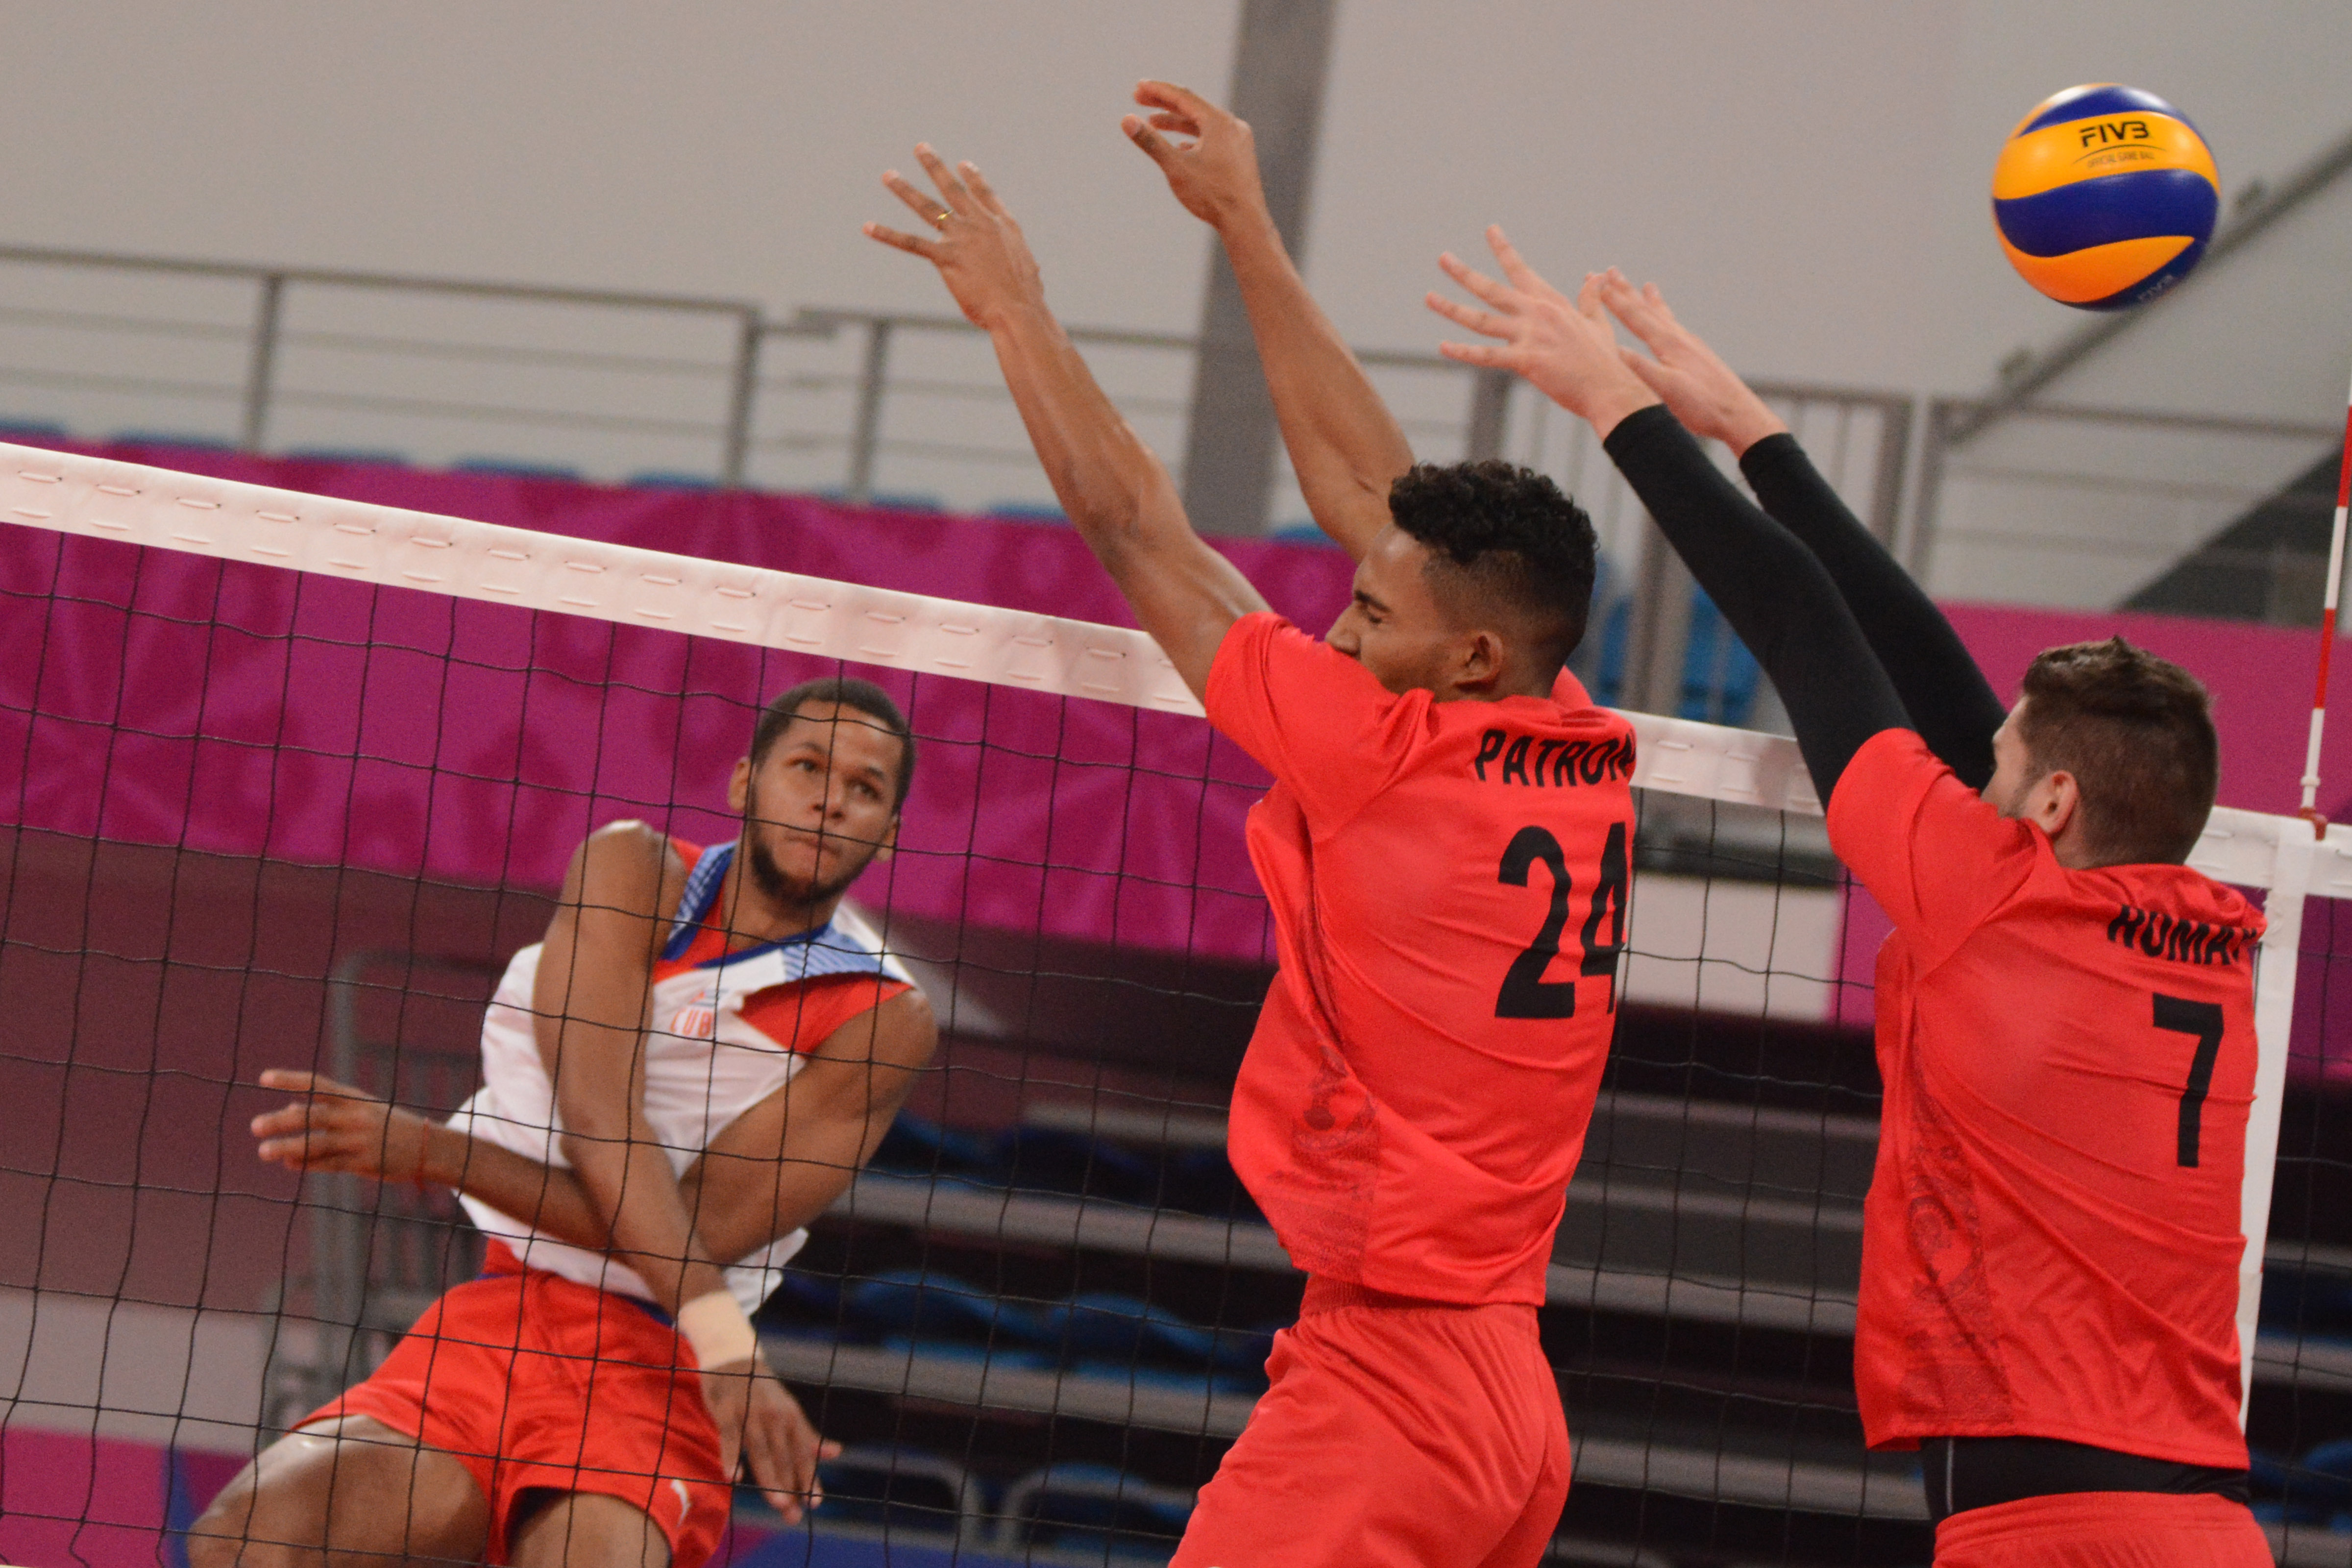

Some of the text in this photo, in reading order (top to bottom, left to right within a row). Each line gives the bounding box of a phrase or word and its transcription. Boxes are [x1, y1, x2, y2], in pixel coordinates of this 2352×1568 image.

[2080, 121, 2149, 147] FIVB
[1474, 729, 1636, 787] PATRON
[1494, 821, 1627, 1019] 24
[2153, 992, 2225, 1168] 7
